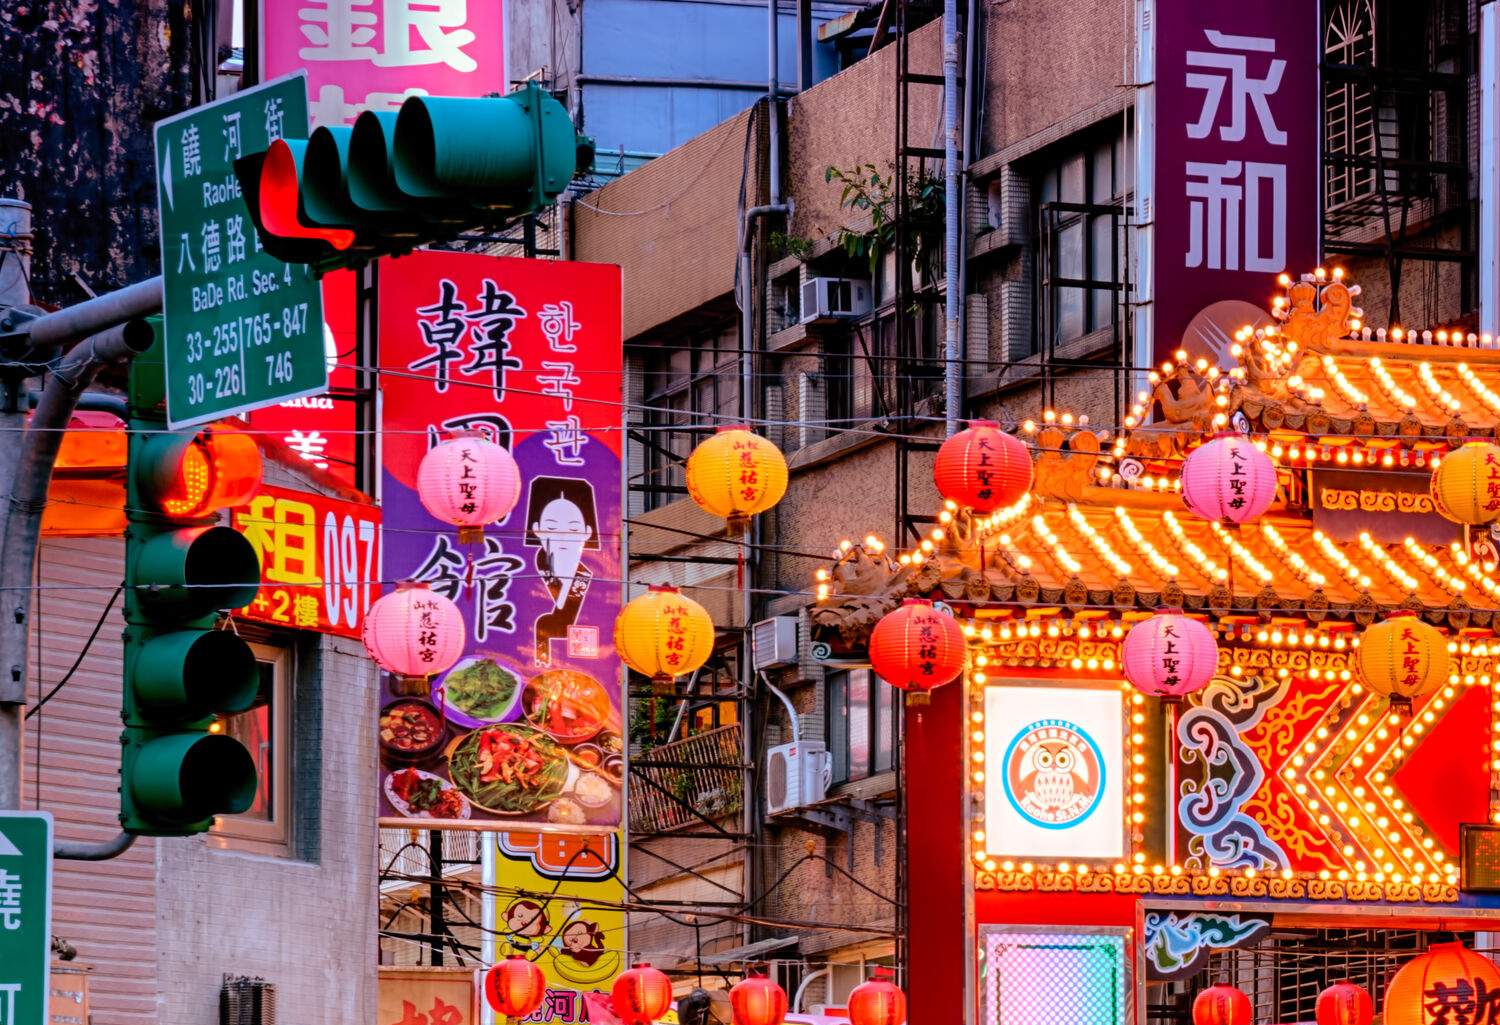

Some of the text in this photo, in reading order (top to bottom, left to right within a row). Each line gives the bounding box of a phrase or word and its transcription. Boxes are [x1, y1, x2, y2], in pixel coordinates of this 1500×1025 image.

[1185, 28, 1289, 274] 永和
[177, 214, 264, 276] 八德路
[192, 262, 292, 312] BaDe Rd. Sec. 4
[186, 302, 309, 364] 33-255 765-847
[188, 363, 240, 405] 30-226
[265, 351, 293, 386] 746
[535, 300, 591, 468] 한국관
[323, 511, 382, 630] 097
